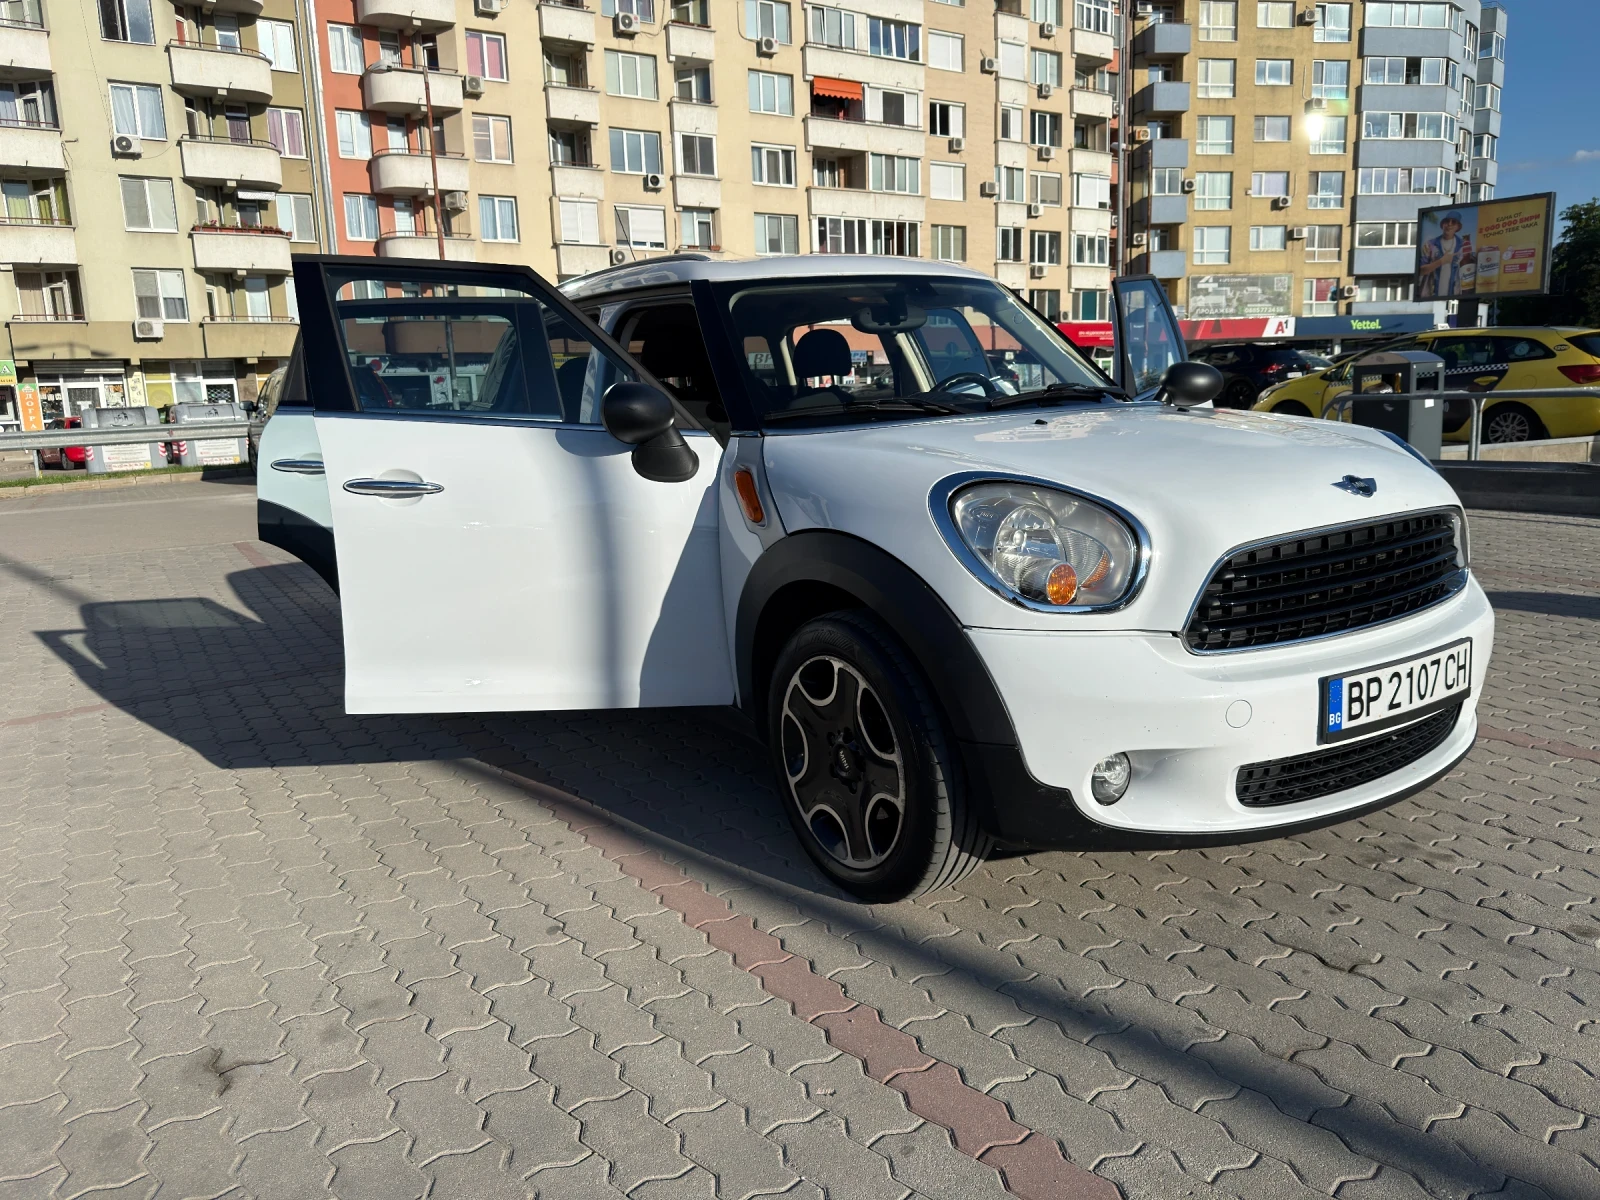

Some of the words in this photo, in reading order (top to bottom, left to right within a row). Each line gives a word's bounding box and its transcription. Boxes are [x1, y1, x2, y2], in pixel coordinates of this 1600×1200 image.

[1484, 223, 1501, 232] 000
[1501, 219, 1518, 228] 000
[1519, 213, 1541, 223] БИРИ
[1496, 214, 1513, 222] ЕДНА
[1483, 229, 1504, 238] ТОЧНО
[1388, 658, 1441, 711] 2107
[1329, 711, 1342, 726] BG
[839, 750, 850, 769] MINI
